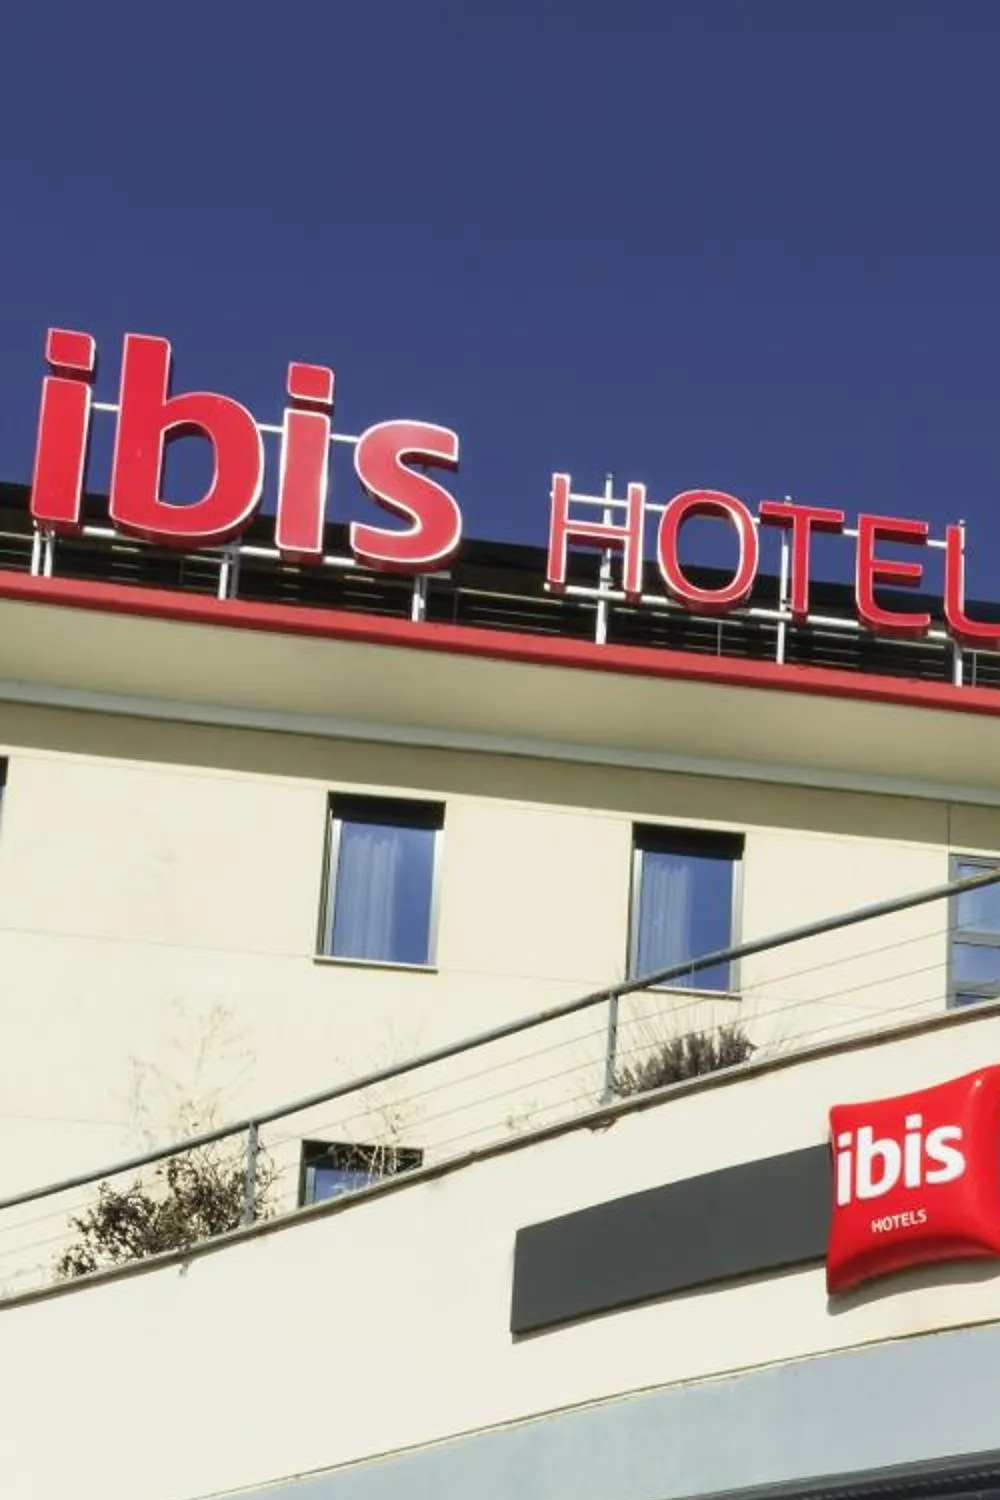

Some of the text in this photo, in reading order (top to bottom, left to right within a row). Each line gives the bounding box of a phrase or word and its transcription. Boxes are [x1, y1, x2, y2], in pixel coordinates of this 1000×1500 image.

[29, 327, 463, 572] ibis
[836, 1114, 967, 1206] ibis
[871, 1208, 928, 1234] HOTELS
